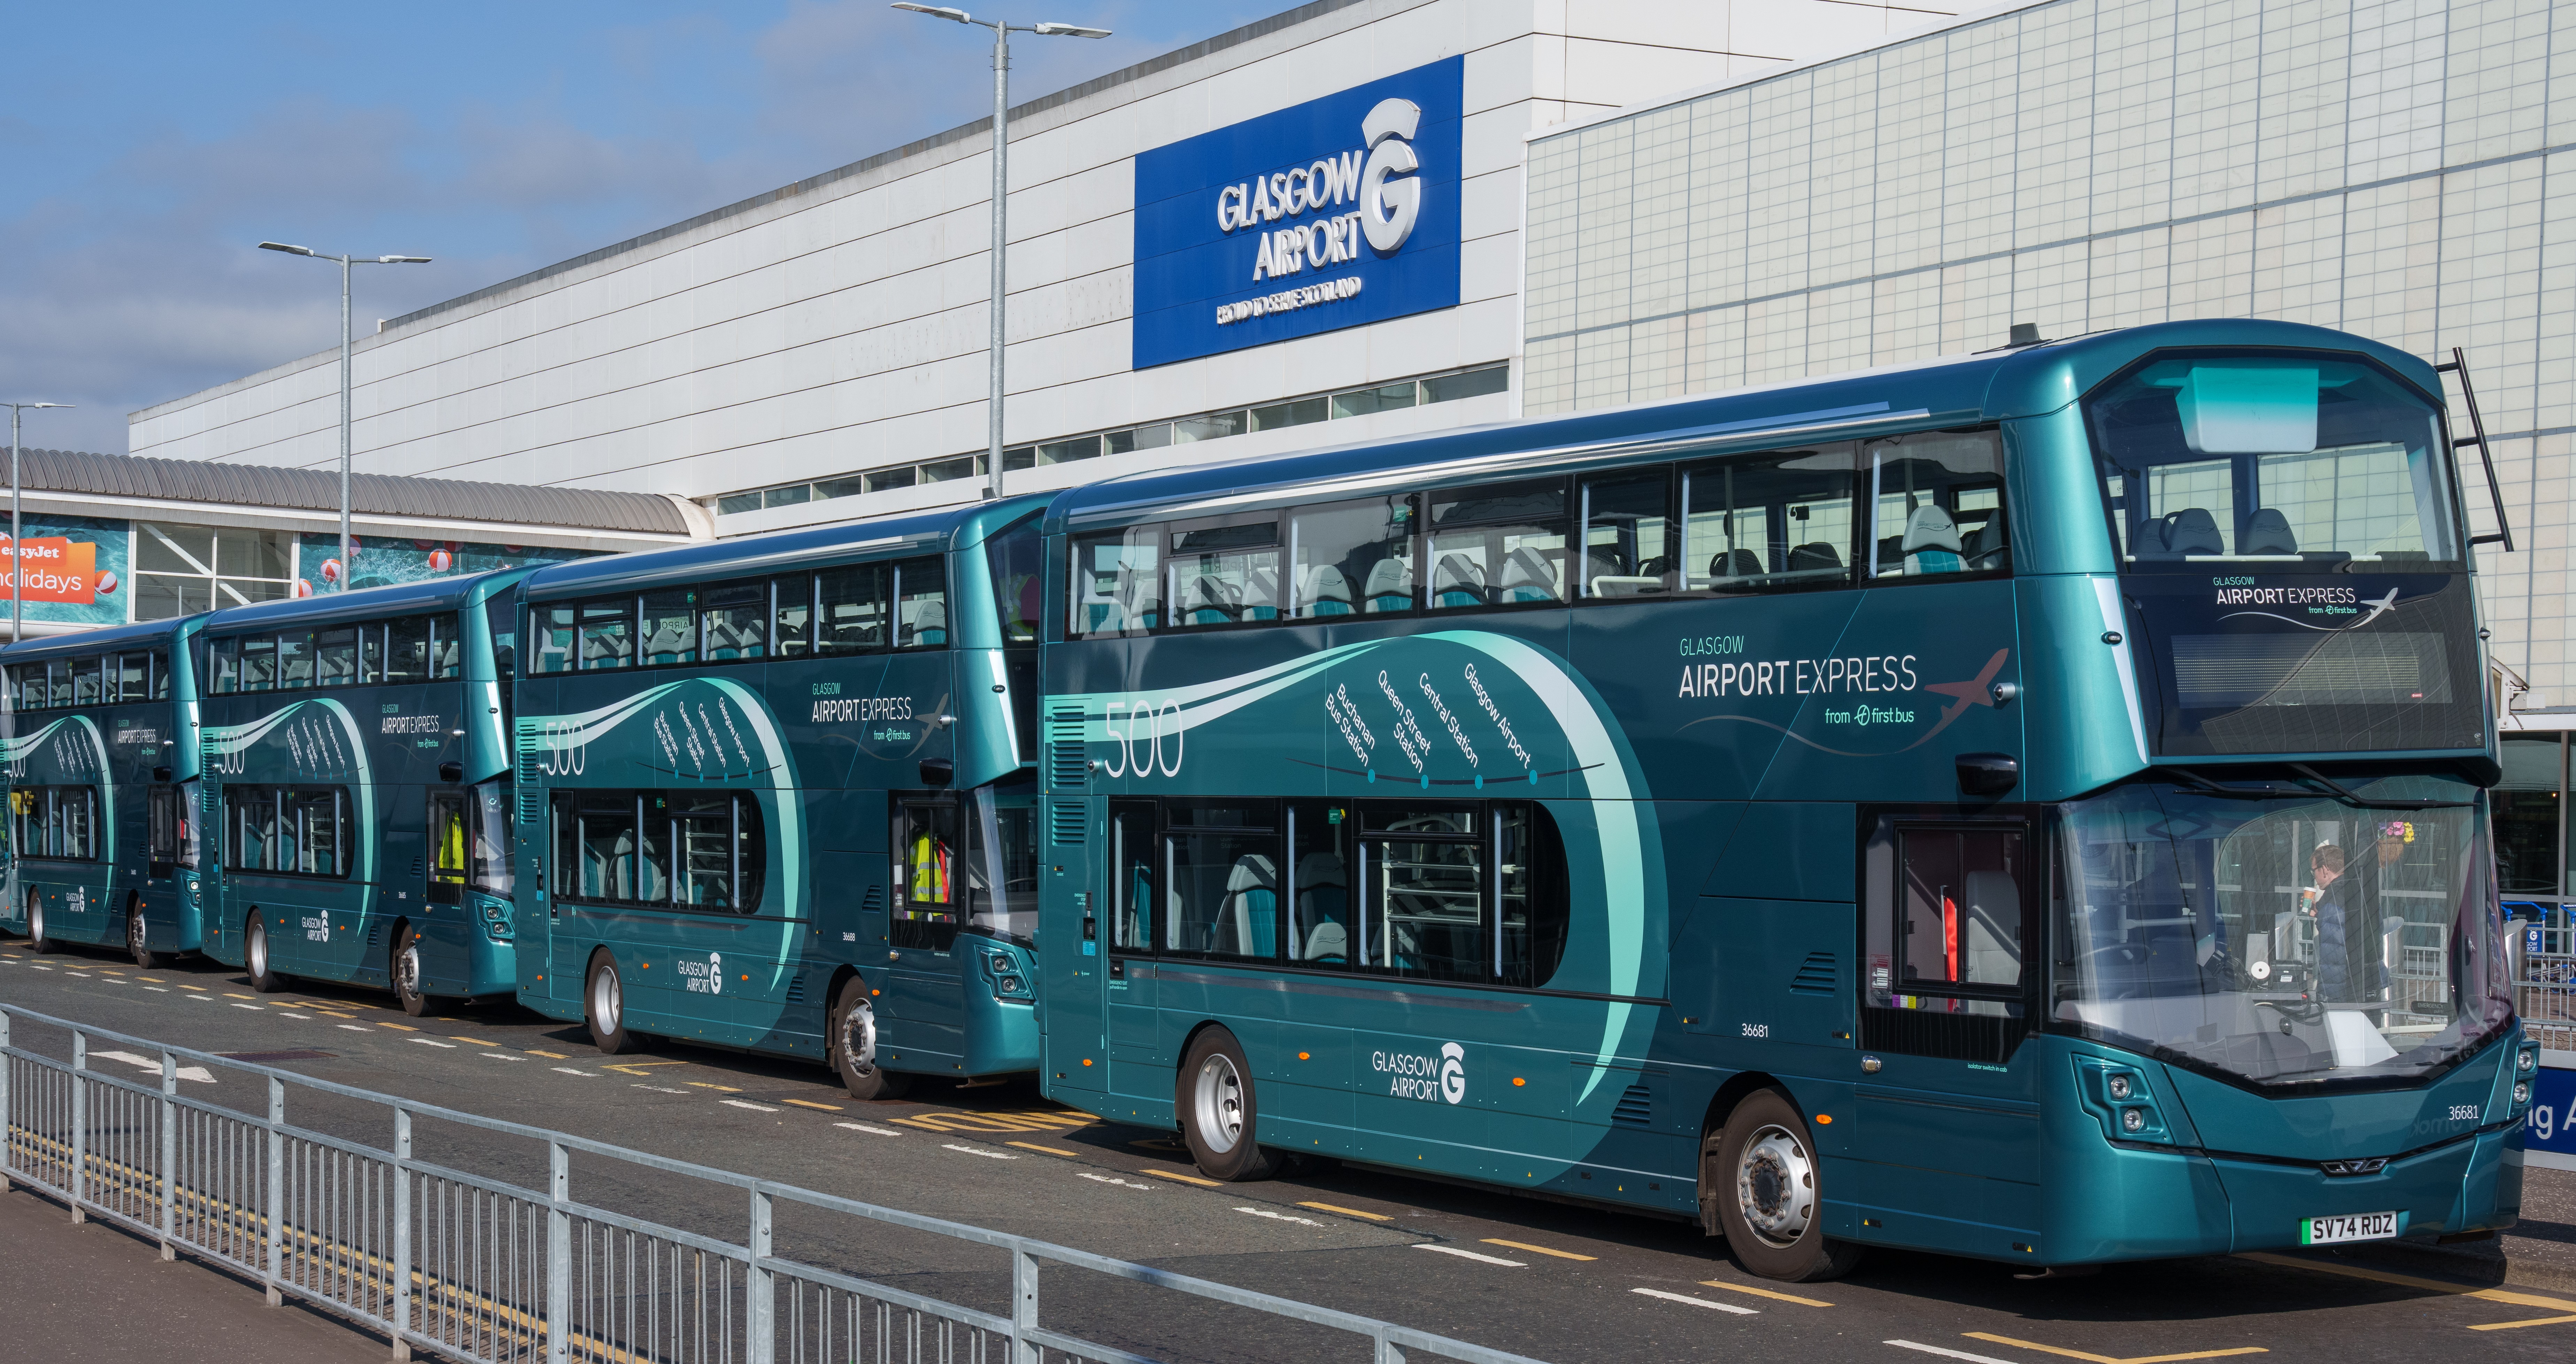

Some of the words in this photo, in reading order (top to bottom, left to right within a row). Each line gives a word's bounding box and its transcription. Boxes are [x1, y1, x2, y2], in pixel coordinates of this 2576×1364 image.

[1218, 150, 1363, 231] GLASGOW
[1253, 211, 1361, 281] AIRPORT
[1217, 300, 1252, 324] PROUD
[1252, 296, 1269, 316] TO
[1268, 288, 1301, 313] SERVE
[1301, 277, 1361, 306] SCOTLAND
[2213, 577, 2254, 586] GLASGOW
[2216, 589, 2284, 604] AIRPORT
[2289, 588, 2355, 603] EXPRESS
[1680, 636, 1744, 656] GLASGOW
[813, 683, 840, 695] GLASGOW
[1679, 661, 1790, 698] AIRPORT
[1796, 655, 1916, 694] EXPRESS
[382, 704, 399, 713] GLASGOW
[812, 699, 859, 722] AIRPORT
[862, 697, 911, 721] EXPRESS
[1336, 683, 1375, 750] Buchanan
[1378, 670, 1404, 716] Queen
[1403, 709, 1431, 756] Street
[1419, 672, 1449, 723] Central
[1448, 716, 1478, 768] Station
[1465, 663, 1499, 721] Glasgow
[1498, 716, 1530, 769] Airport
[1825, 708, 1850, 724] from
[1872, 707, 1893, 723] first
[1895, 707, 1914, 723] bus
[118, 730, 136, 744] AIRPORT
[137, 729, 156, 743] EXPRESS
[382, 717, 409, 734] AIRPORT
[410, 715, 439, 733] EXPRESS
[659, 710, 679, 755] Buchanan
[679, 701, 692, 733] Queen
[691, 727, 705, 760] Street
[699, 703, 713, 738] Central
[711, 733, 726, 768] Station
[719, 697, 735, 736] Glasgow
[734, 733, 749, 767] Airport
[874, 731, 884, 740] from
[893, 730, 902, 740] first
[902, 730, 910, 740] bus
[1325, 693, 1340, 724] Bus
[1340, 718, 1369, 767] Station
[546, 720, 585, 775] 500
[661, 734, 675, 767] Station
[1104, 698, 1183, 778] 500
[1394, 722, 1423, 773] Station
[8, 742, 25, 777] 500
[219, 730, 245, 774] 500
[686, 737, 701, 772] Station
[66, 892, 79, 901] GLASGOW
[70, 903, 79, 912] AIRPORT
[302, 916, 321, 928] GLASGOW
[307, 930, 321, 941] AIRPORT
[843, 932, 855, 941] 36688
[678, 960, 709, 977] GLASGOW
[687, 978, 709, 993] AIRPORT
[1742, 1023, 1768, 1038] 36681
[1373, 1051, 1438, 1077] GLASGOW
[1390, 1076, 1439, 1101] AIRPORT
[2449, 1105, 2478, 1120] 36681
[2314, 1217, 2356, 1239] SV74
[2362, 1214, 2392, 1235] RDZ
